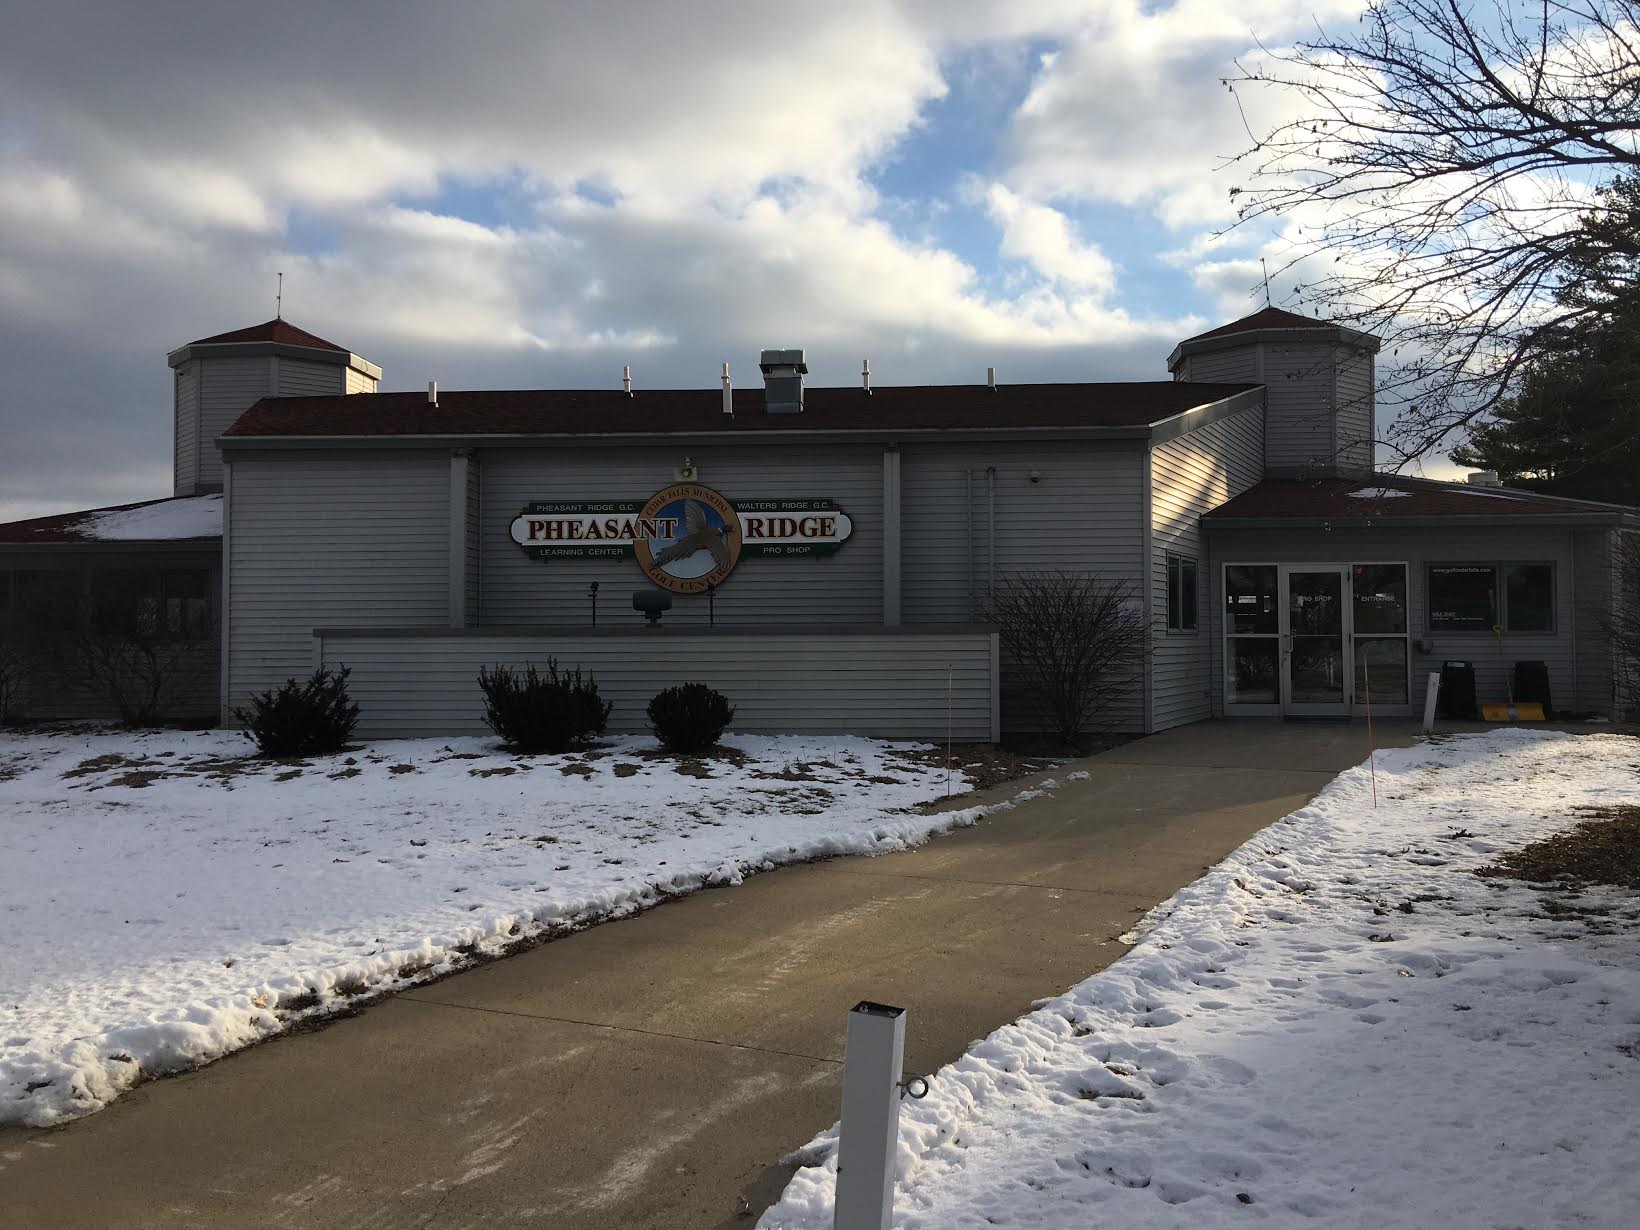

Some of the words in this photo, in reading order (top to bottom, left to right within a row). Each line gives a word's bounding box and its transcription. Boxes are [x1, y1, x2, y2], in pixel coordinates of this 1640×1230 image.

[646, 495, 666, 516] CEDAR
[667, 488, 690, 499] FALLS
[692, 488, 728, 513] MUNICIPAL
[737, 502, 777, 510] WALTERS
[813, 501, 830, 509] G.C.
[536, 504, 583, 512] PHEASANT
[527, 518, 678, 540] PHEASANT
[745, 517, 836, 538] RIDGE
[540, 548, 583, 556] LEARNING
[588, 548, 624, 556] CENTER
[786, 546, 811, 554] SHOP
[648, 566, 674, 587] GOLF
[680, 567, 726, 590] CENTER
